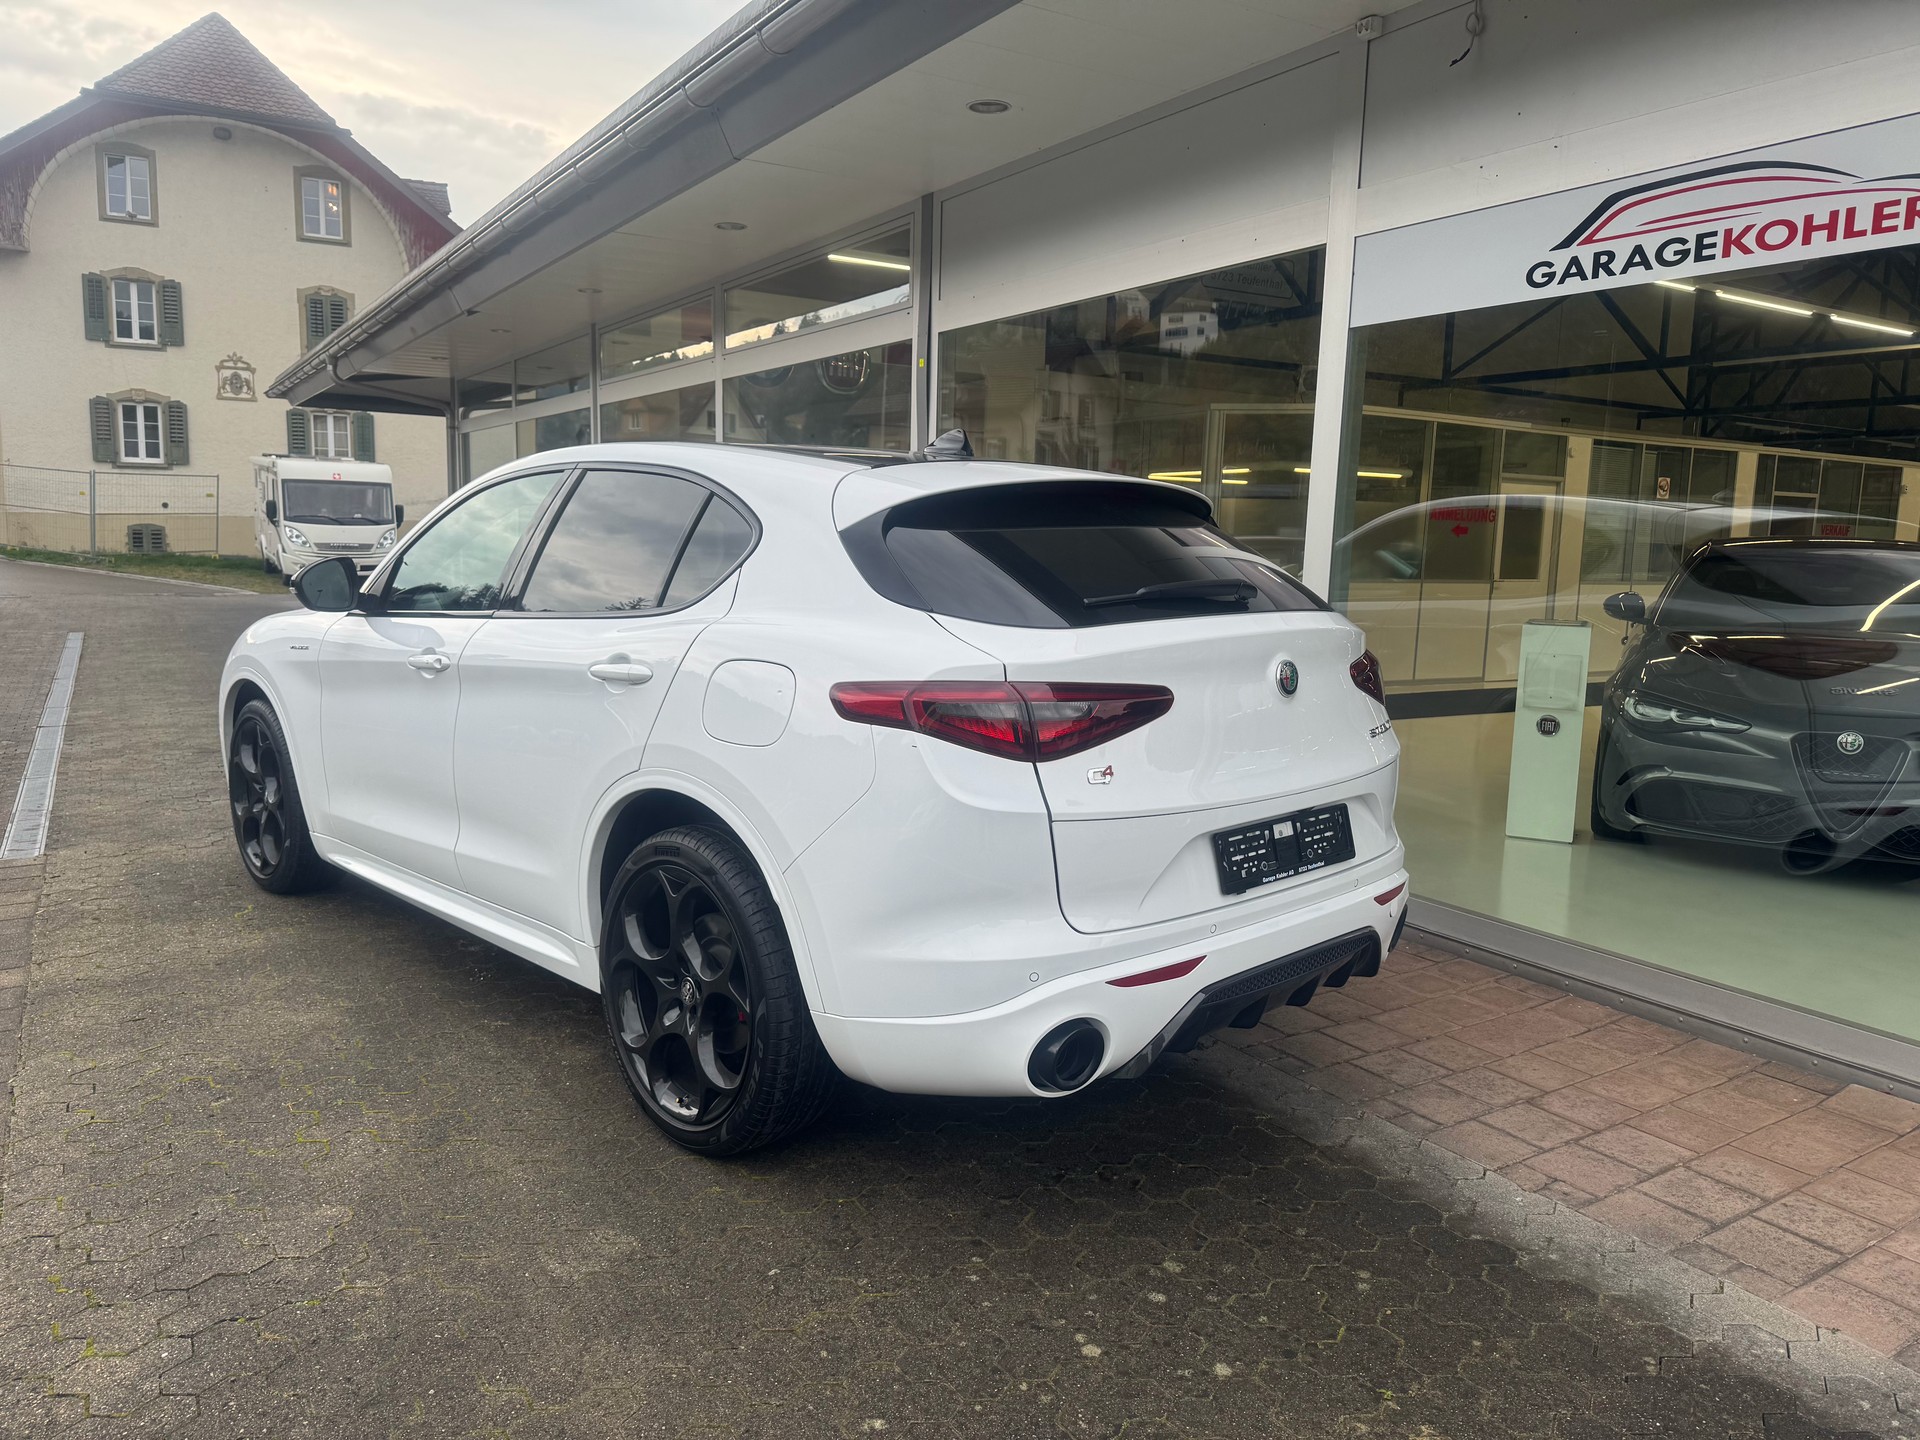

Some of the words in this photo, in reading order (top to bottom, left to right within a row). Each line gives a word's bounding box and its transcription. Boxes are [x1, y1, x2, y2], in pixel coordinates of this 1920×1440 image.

[1237, 273, 1283, 290] Teufenthal
[1429, 508, 1497, 522] ANMELDUNG
[1821, 524, 1850, 536] VERKAUF
[1541, 720, 1556, 732] FIAT
[1087, 765, 1114, 785] Q4
